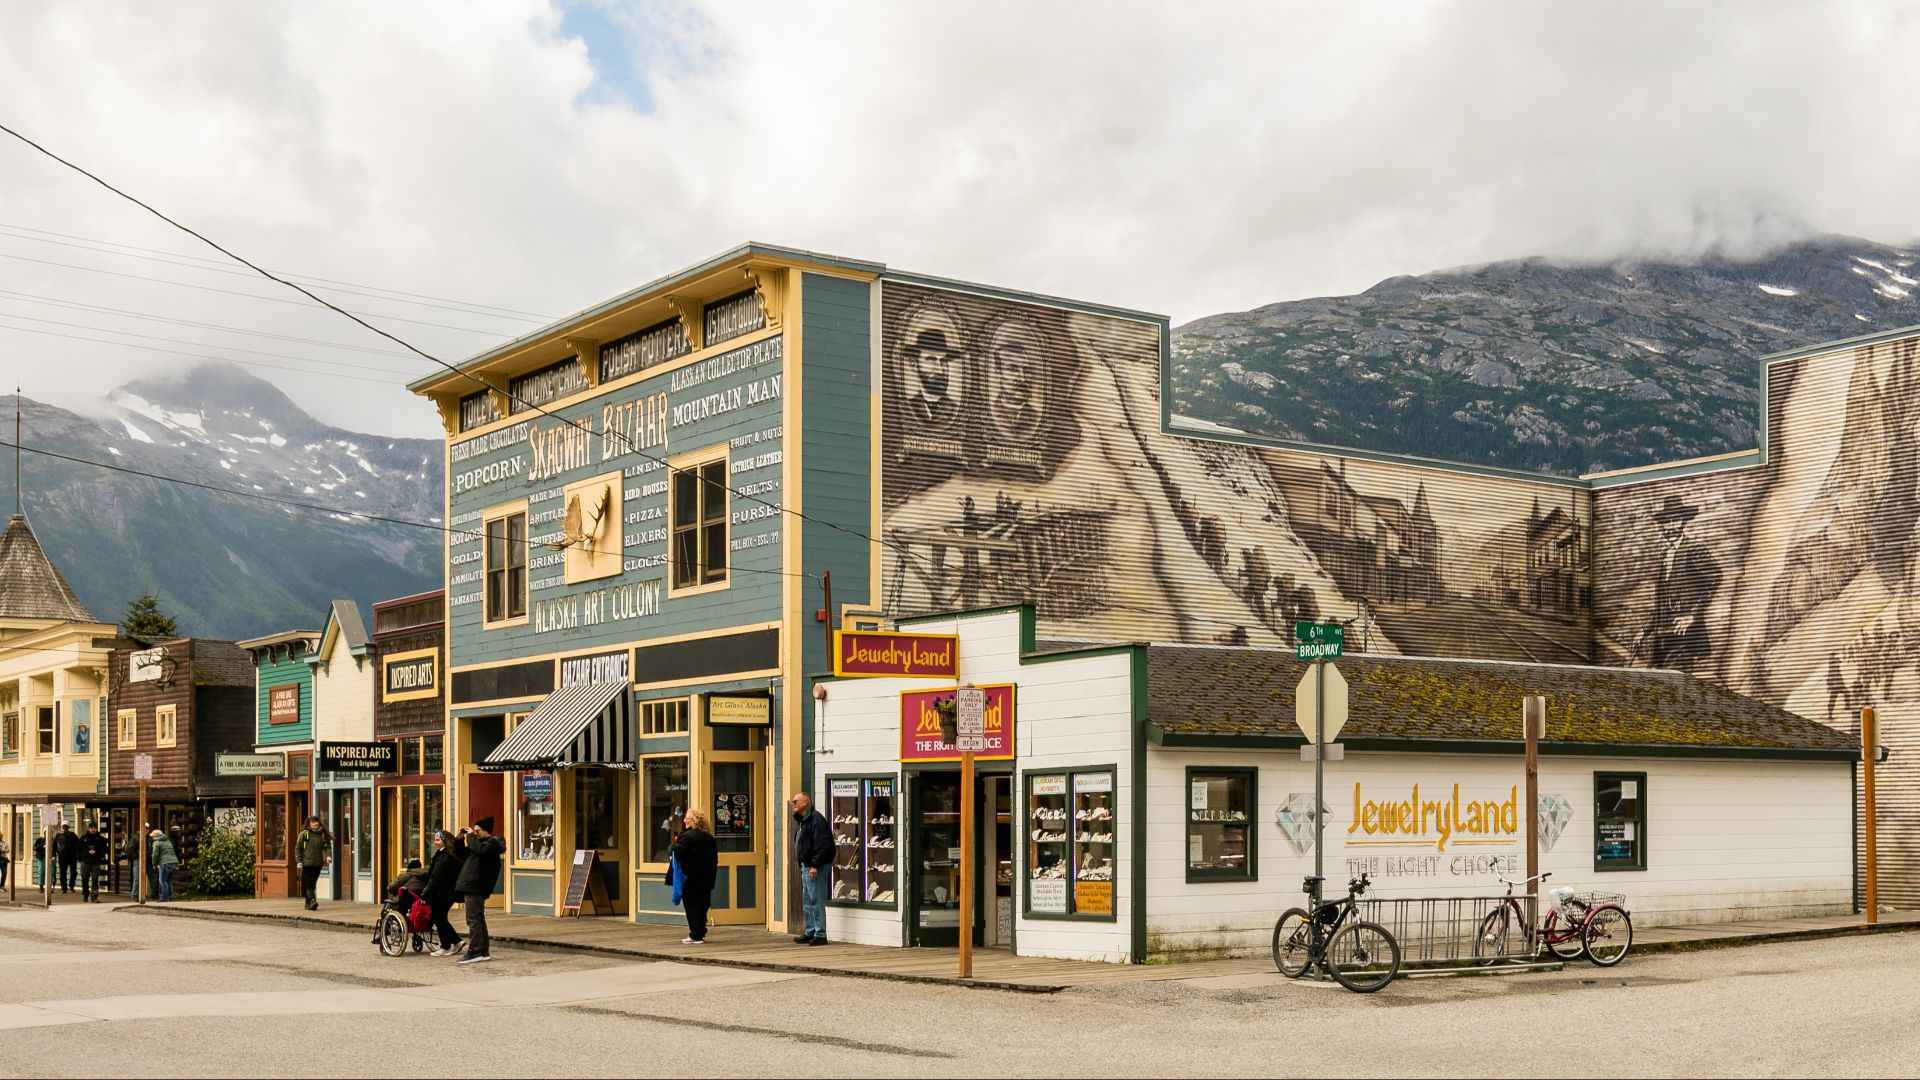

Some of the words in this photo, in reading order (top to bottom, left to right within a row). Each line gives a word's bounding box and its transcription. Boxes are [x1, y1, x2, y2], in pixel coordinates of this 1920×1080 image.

[707, 302, 737, 343] OSTRICH
[738, 296, 763, 330] GOODS
[602, 341, 637, 380] POLISH
[671, 361, 704, 393] ALASKAN
[707, 350, 751, 379] COLLECTOR
[754, 336, 782, 365] PLATE
[511, 370, 553, 411] KLONDIKE
[559, 360, 589, 392] CAND
[672, 387, 741, 427] MOUNTAIN
[747, 375, 781, 405] MAN
[452, 441, 470, 462] FRESH
[471, 434, 487, 456] MADE
[490, 423, 527, 449] CHOCOLATES
[528, 415, 593, 480] SKAGWAY
[602, 391, 669, 461] BAZAAR
[730, 433, 752, 449] FRUIT
[754, 432, 760, 441] &
[762, 427, 782, 441] NUTS
[625, 458, 666, 477] LINENS
[731, 459, 753, 474] OSTRICH
[756, 451, 782, 467] LEATHER
[457, 456, 521, 492] POPCORN
[529, 492, 547, 504] MADE
[624, 487, 640, 501] BIRD
[642, 480, 668, 497] HOUSES
[738, 481, 773, 498] BELTS
[530, 509, 565, 525] BRITTLES
[629, 508, 662, 524] PIZZA
[732, 503, 781, 524] PURSES
[530, 531, 566, 548] TRUFFLES
[625, 528, 666, 546] ELIXERS
[453, 550, 480, 565] GOLD
[530, 552, 565, 570] DRINKS
[624, 554, 667, 571] CLOCKS
[451, 570, 483, 585] AMMOLITE
[451, 592, 483, 606] TANZANITE
[535, 594, 578, 633] ALASKA
[584, 589, 607, 625] ART
[613, 579, 661, 620] COLONY
[1300, 643, 1339, 657] BROADWAY
[391, 665, 417, 690] INSPIRED
[418, 662, 433, 686] ARTS
[563, 659, 590, 688] BAZAAR
[592, 653, 628, 684] ENTRANCE
[725, 701, 743, 709] Glass
[746, 702, 767, 710] Alaska
[327, 746, 369, 758] INSPIRED
[370, 747, 391, 759] ARTS
[916, 741, 933, 751] THE
[359, 760, 379, 768] Original
[1346, 856, 1379, 877] THE
[1386, 856, 1441, 877] RIGHT
[1450, 855, 1518, 876] CHOICE
